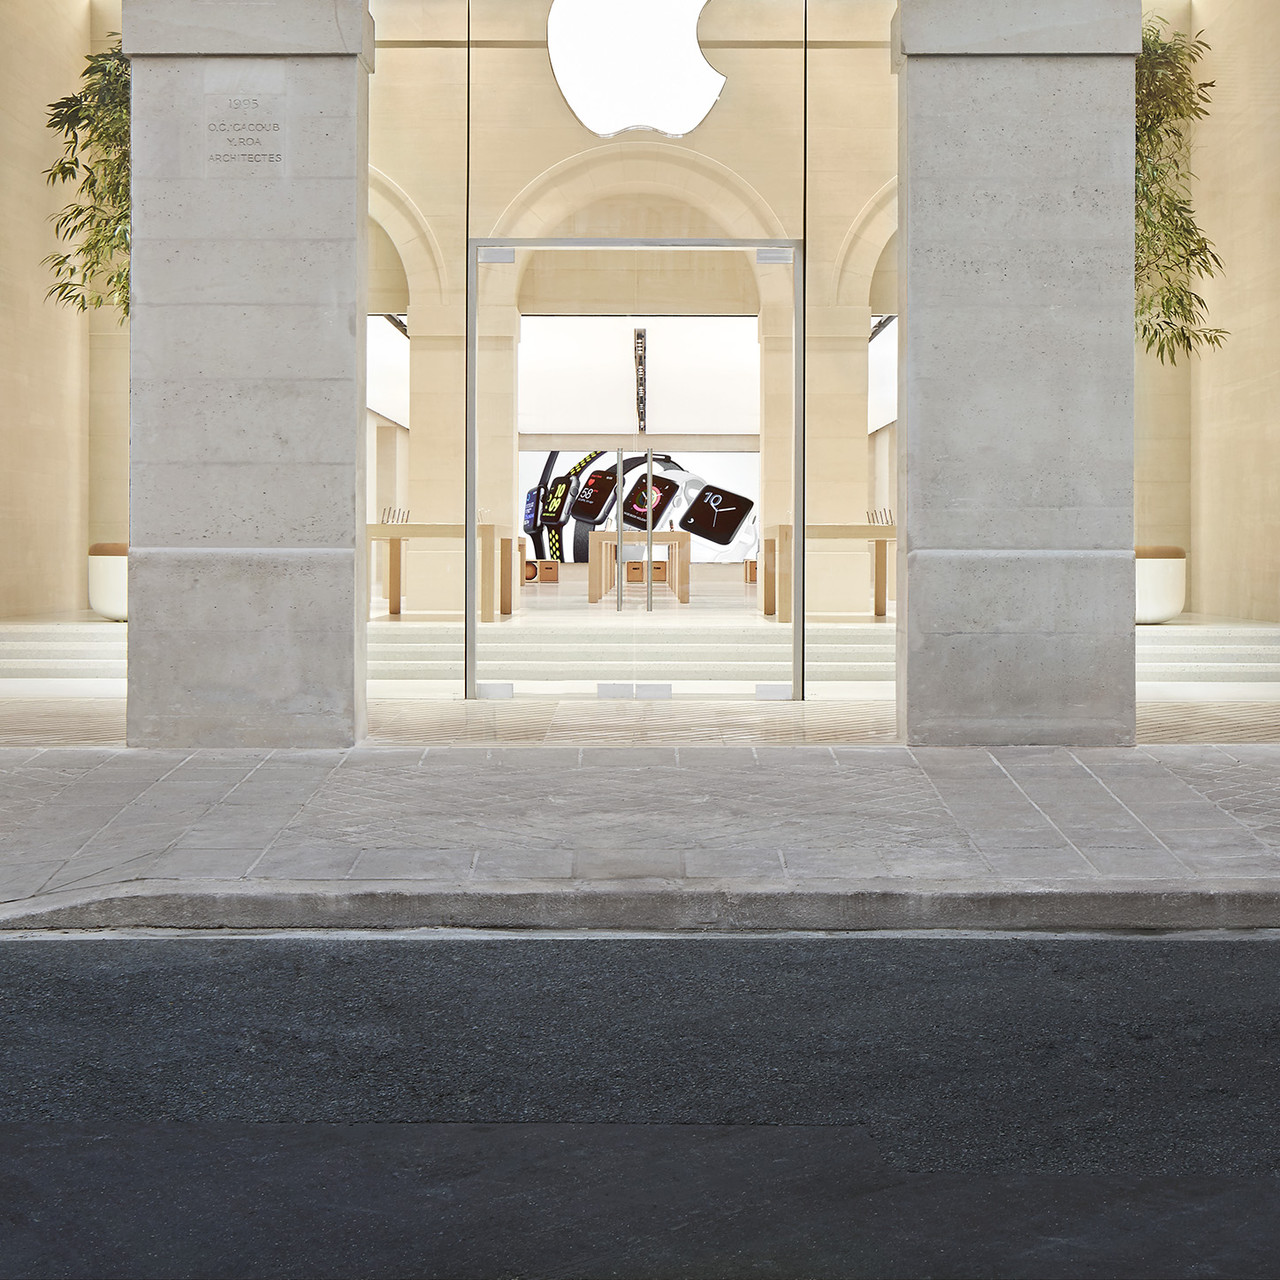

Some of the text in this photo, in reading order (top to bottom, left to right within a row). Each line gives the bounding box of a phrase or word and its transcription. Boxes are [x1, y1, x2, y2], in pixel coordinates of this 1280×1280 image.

[228, 98, 259, 109] 1995
[208, 153, 282, 163] ARCHITECTES
[555, 483, 566, 498] 10
[580, 487, 594, 499] 58
[548, 498, 562, 512] 09
[703, 492, 723, 506] 10
